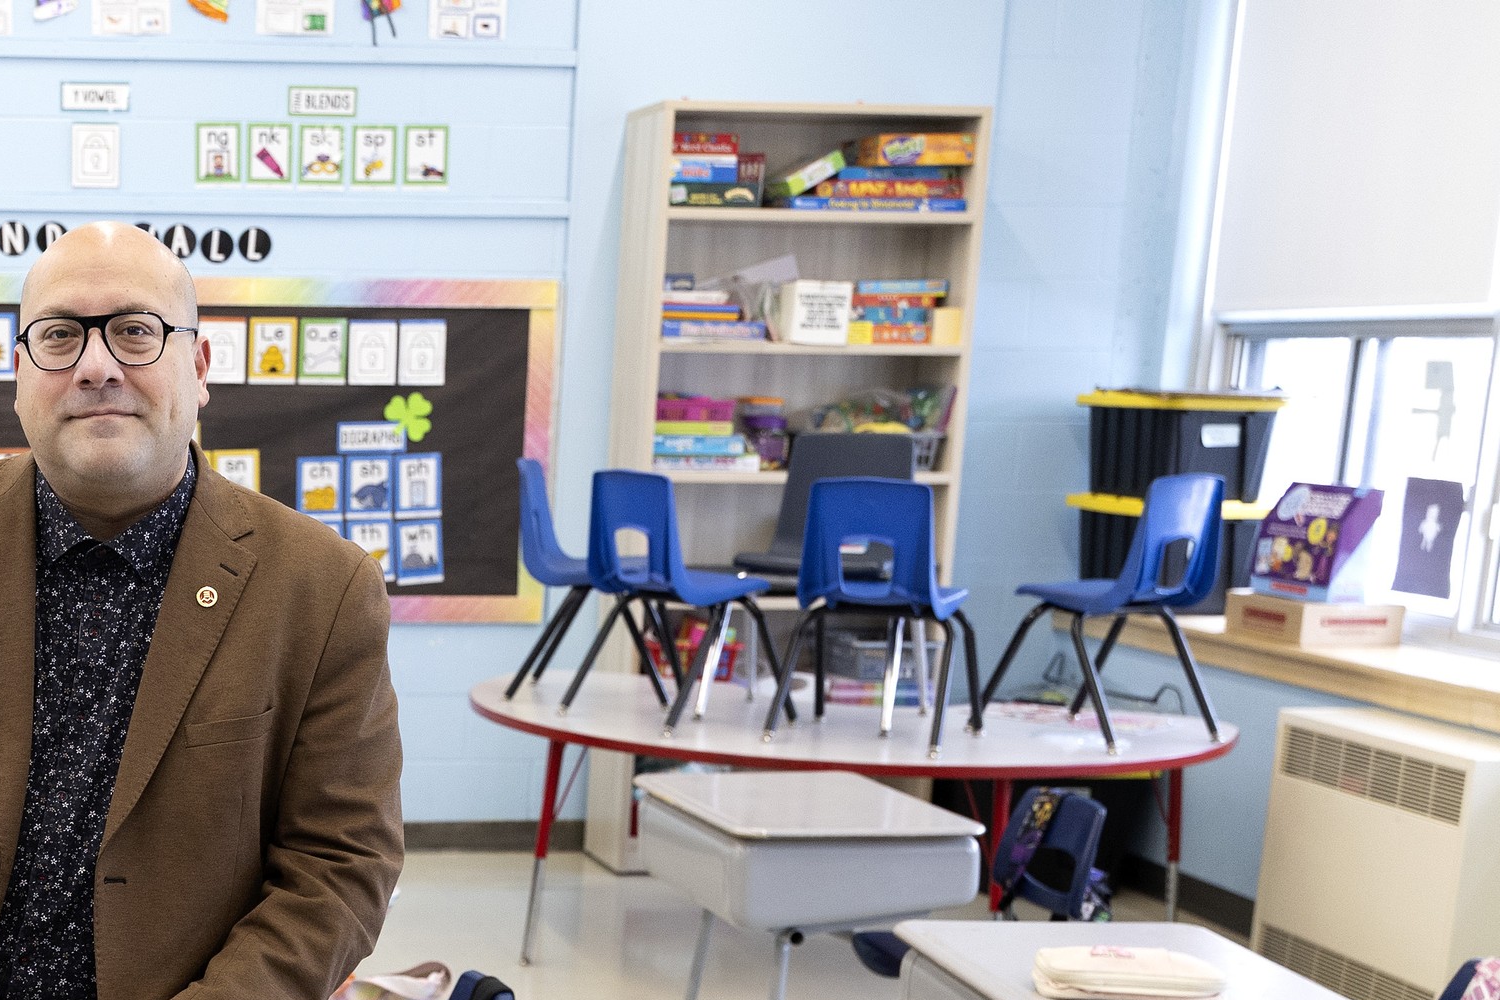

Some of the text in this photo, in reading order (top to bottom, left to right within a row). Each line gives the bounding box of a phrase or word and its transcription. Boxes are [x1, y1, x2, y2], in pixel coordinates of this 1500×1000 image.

[82, 89, 117, 103] VOWEL
[305, 94, 350, 110] BLENDS
[206, 130, 229, 147] ng
[258, 127, 281, 146] nk
[310, 128, 332, 147] sk
[363, 132, 387, 149] sp
[415, 128, 436, 147] st
[155, 224, 265, 262] ALL
[225, 460, 247, 473] sn
[309, 461, 332, 479] ch
[360, 459, 382, 477] sh
[406, 459, 430, 480] ph
[360, 526, 382, 542] th
[405, 525, 433, 543] wh
